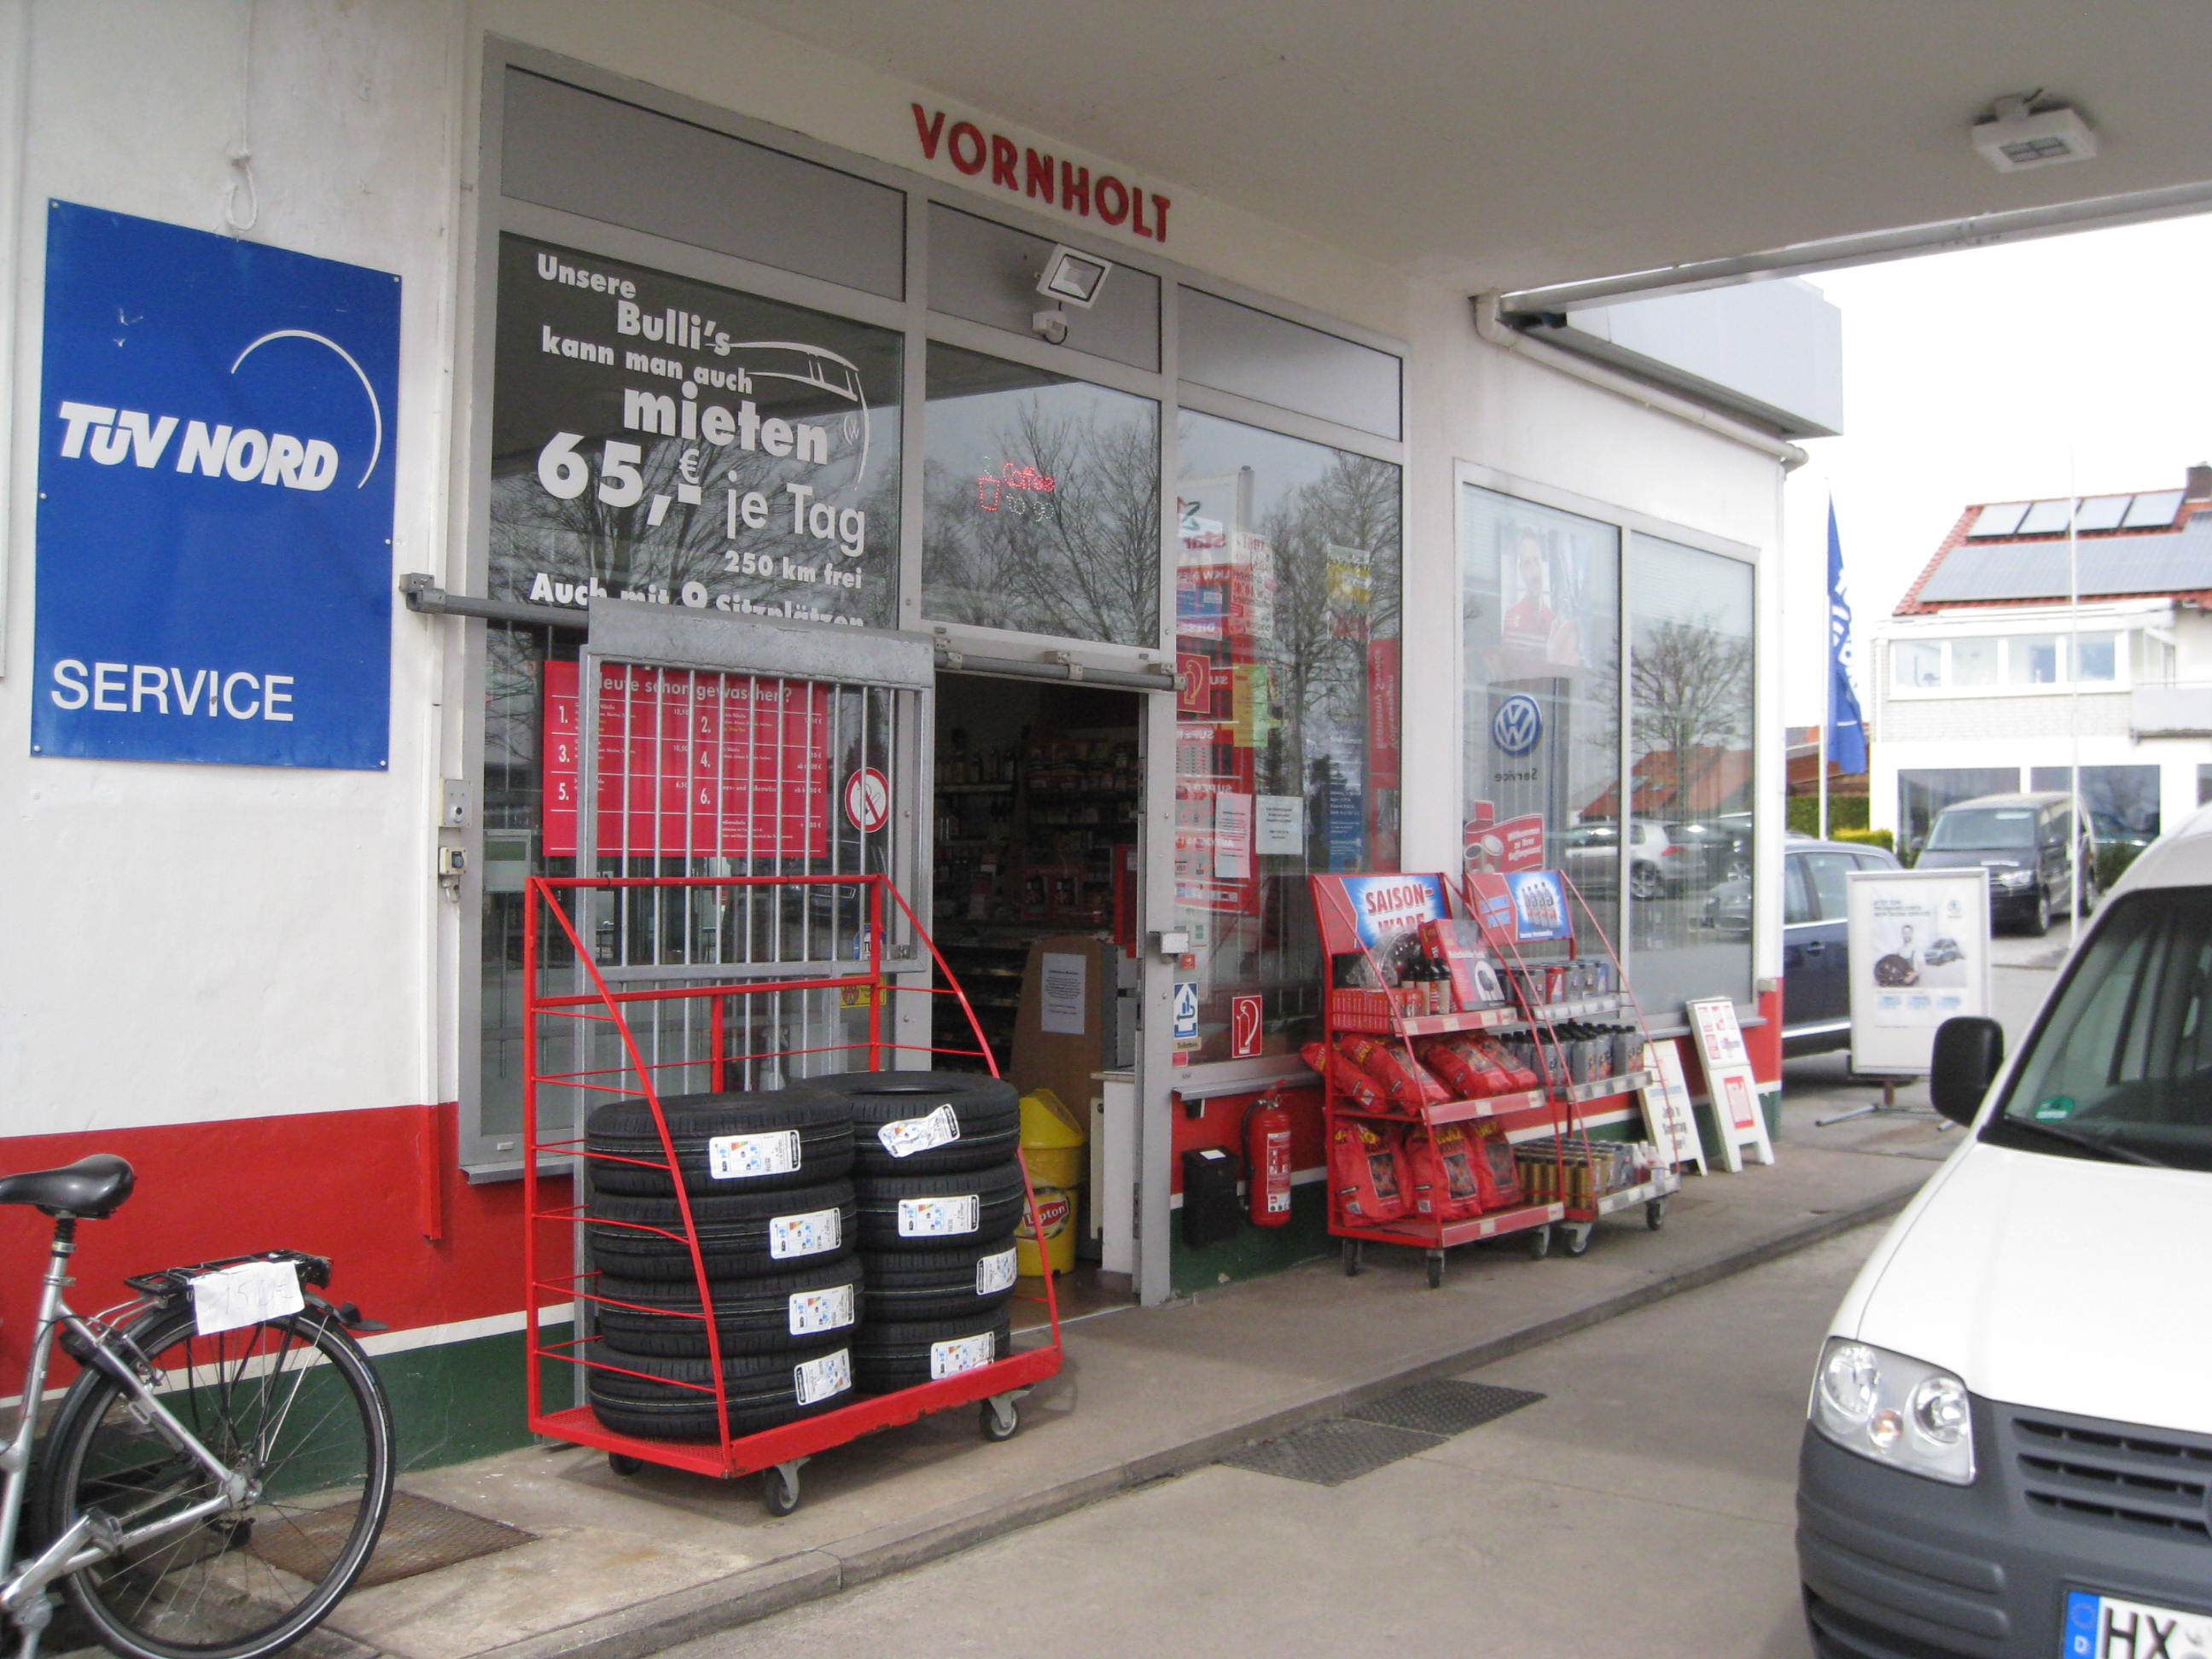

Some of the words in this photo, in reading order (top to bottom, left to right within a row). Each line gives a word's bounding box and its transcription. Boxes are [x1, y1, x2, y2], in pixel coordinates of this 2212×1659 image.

[911, 102, 1171, 242] VORNHOLT
[538, 253, 636, 300] Unsere
[617, 300, 731, 357] Bulli's
[542, 325, 614, 365] kann
[626, 347, 683, 381] man
[693, 364, 753, 394] auch
[624, 381, 828, 464] mieten
[58, 401, 178, 469] TÜV
[177, 419, 339, 492] NORD
[727, 469, 767, 539] je
[786, 482, 864, 556] Tag
[725, 550, 774, 577] 250
[783, 556, 816, 583] km
[824, 562, 862, 589] frei
[529, 572, 608, 606] Auch
[51, 658, 294, 722] SERVICE
[559, 705, 568, 724] 1.
[701, 715, 711, 733] 2.
[559, 744, 570, 763] 3.
[700, 750, 711, 768] 4.
[558, 783, 569, 800] 5.
[700, 788, 711, 805] 6.
[1365, 883, 1435, 915] SAISON-
[1026, 1204, 1066, 1225] Lpton
[2074, 1635, 2089, 1655] D
[2102, 1606, 2177, 1659] HX
